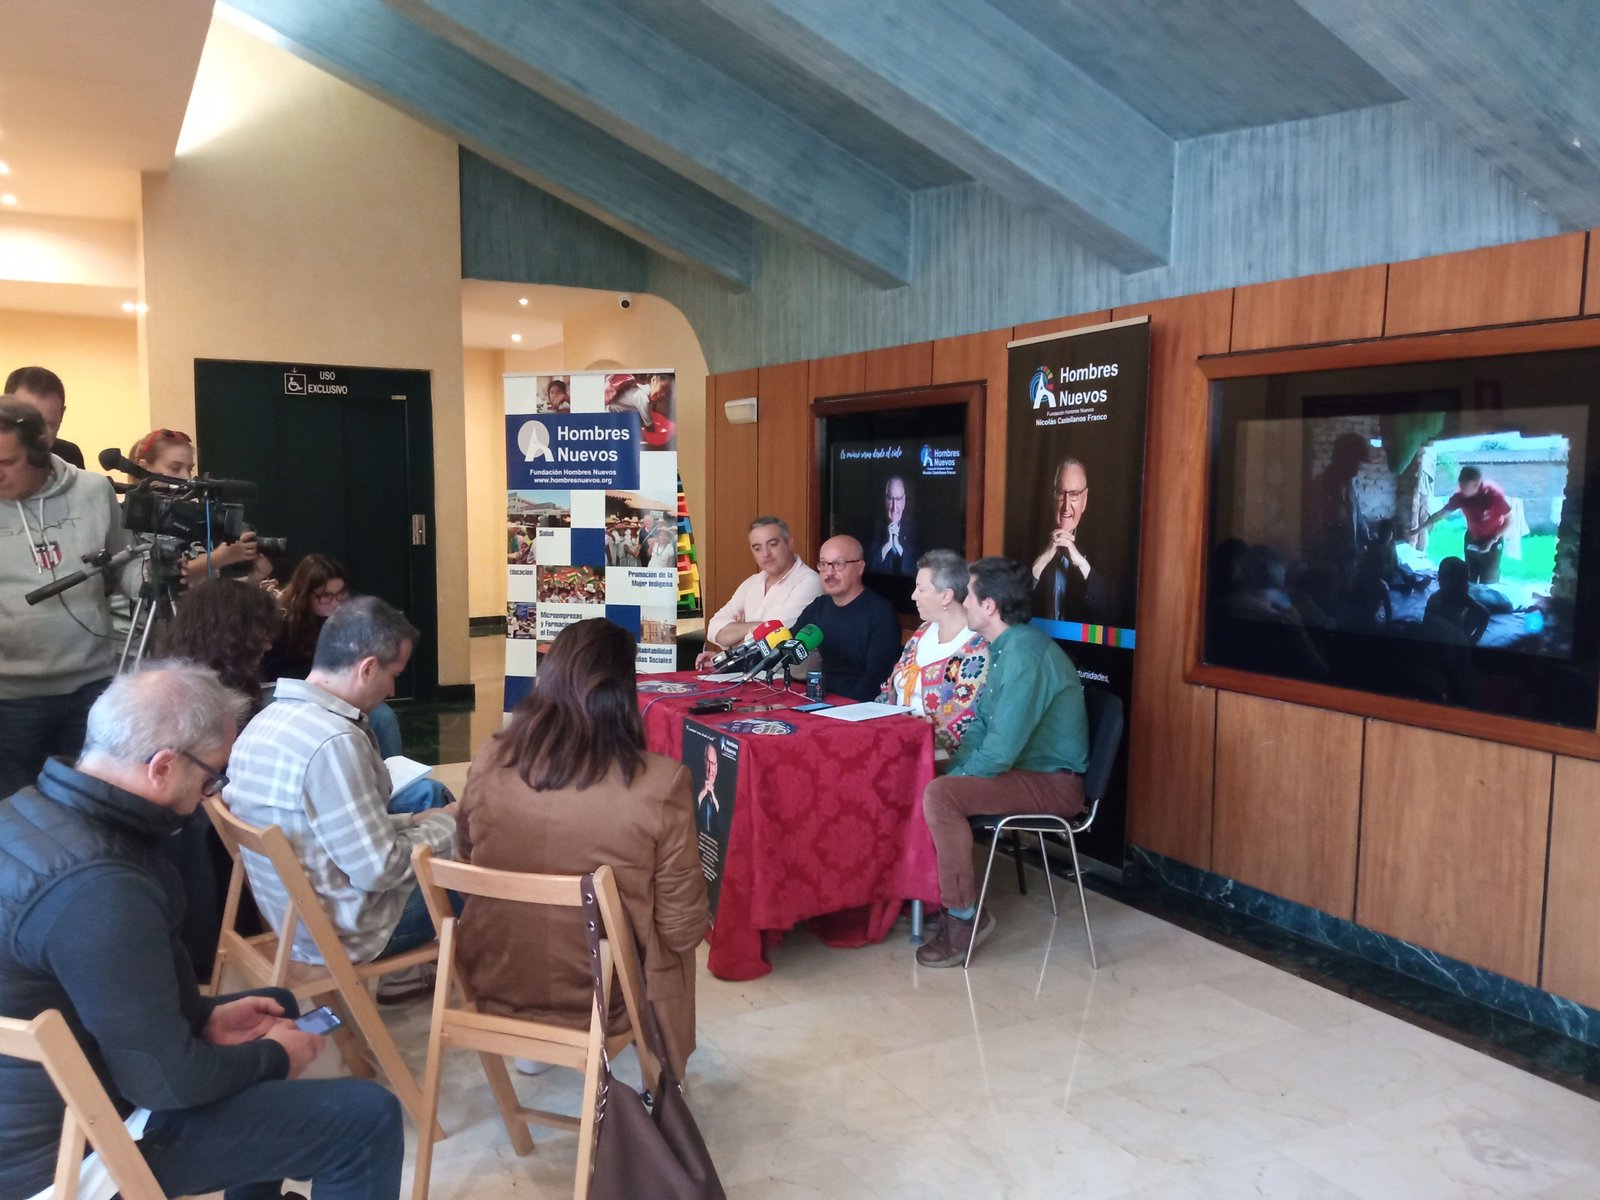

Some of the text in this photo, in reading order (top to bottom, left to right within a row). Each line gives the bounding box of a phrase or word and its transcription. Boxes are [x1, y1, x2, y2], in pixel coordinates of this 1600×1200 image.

[320, 371, 336, 380] USO
[1060, 363, 1119, 383] Hombres
[308, 384, 348, 394] EXCLUSIVO
[1060, 389, 1108, 407] Nuevos
[1036, 413, 1108, 426] Nicolás Castellanos Franco
[557, 426, 630, 441] Hombres
[557, 447, 618, 462] Nuevos
[934, 449, 960, 457] Hombres
[540, 611, 582, 619] Microempresas
